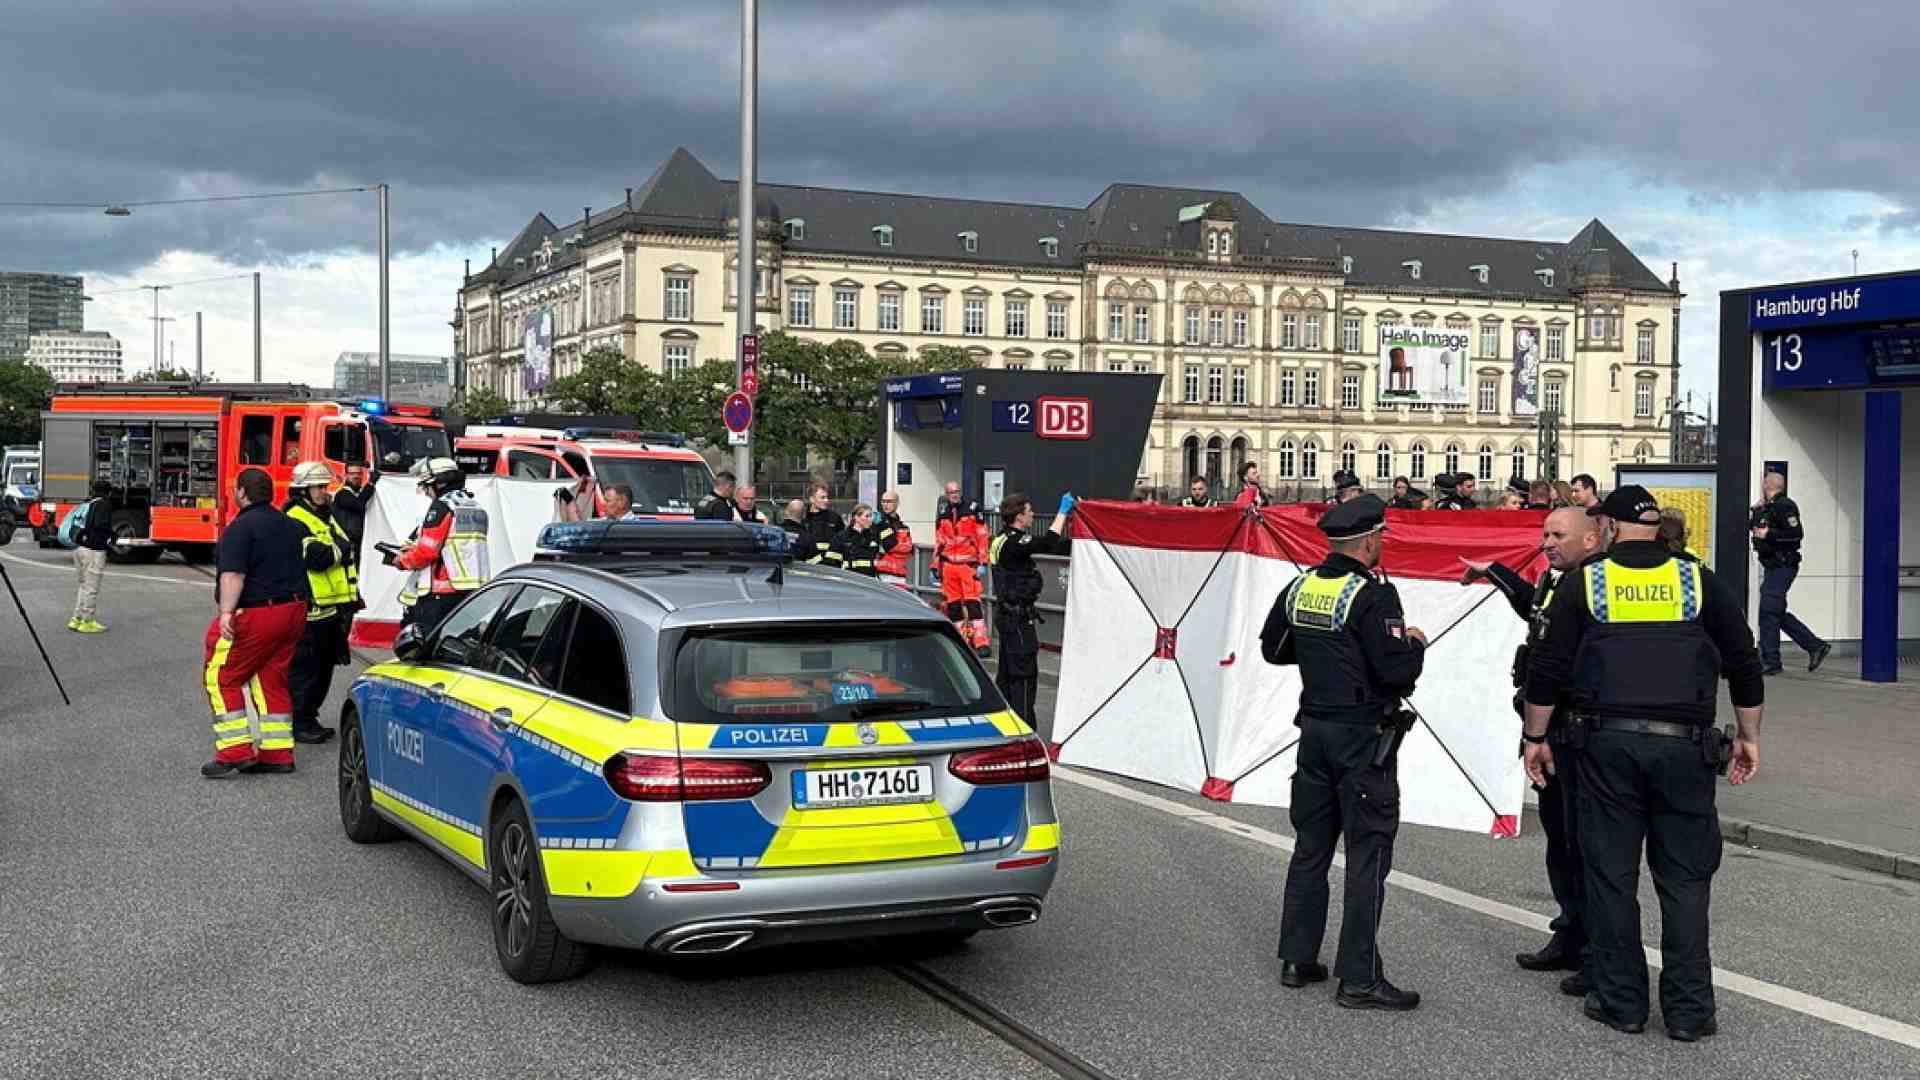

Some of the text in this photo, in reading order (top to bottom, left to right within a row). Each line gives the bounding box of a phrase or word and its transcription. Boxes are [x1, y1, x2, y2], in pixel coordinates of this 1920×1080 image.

[1756, 288, 1861, 317] Hamburg Hbf
[1382, 327, 1468, 352] Hello Image
[1770, 333, 1803, 371] 13
[1008, 403, 1030, 424] 12
[1046, 405, 1085, 431] DB
[1297, 592, 1336, 610] POLIZEI
[1615, 585, 1674, 602] POLIZEI
[388, 721, 424, 766] POLIZEI
[731, 728, 808, 744] POLIZEI
[818, 770, 920, 797] HH 7160
